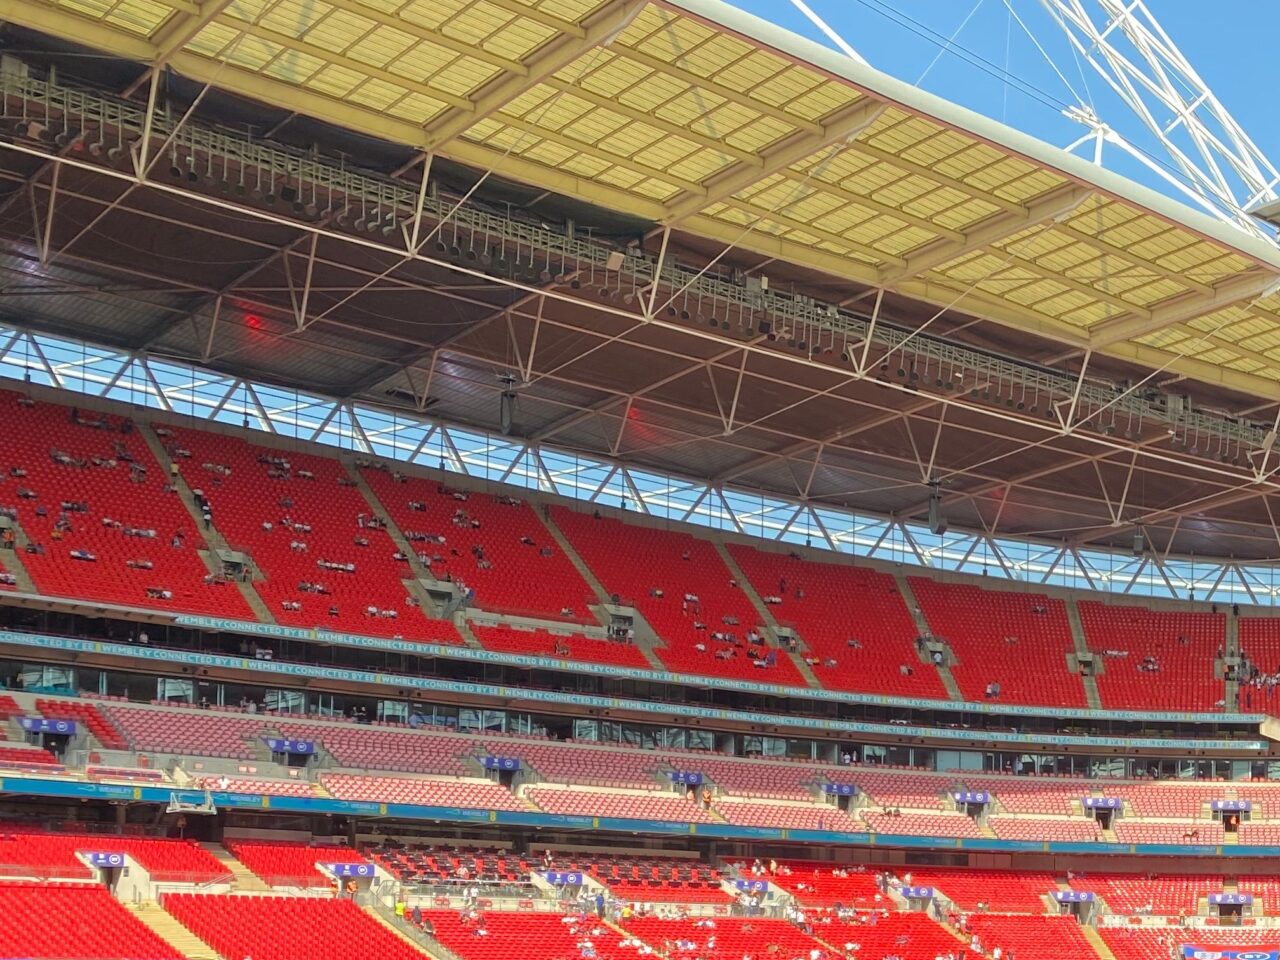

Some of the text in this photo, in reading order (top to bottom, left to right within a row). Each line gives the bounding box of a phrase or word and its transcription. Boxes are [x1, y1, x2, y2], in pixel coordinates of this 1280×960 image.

[175, 615, 223, 627] WEMBLEY
[223, 621, 282, 634] CONNECTED
[283, 628, 299, 636] BY
[65, 639, 80, 648] BY
[316, 632, 361, 644] WEMBLEY
[361, 637, 415, 650] CONNECTED
[416, 644, 428, 652] BY
[102, 644, 152, 656] WEMBLEY
[153, 650, 213, 663] CONNECTED
[214, 657, 229, 665] BY
[446, 647, 488, 659] WEMBLEY
[487, 652, 536, 665] CONNECTED
[248, 660, 294, 672] WEMBLEY
[294, 665, 349, 678] CONNECTED
[350, 671, 364, 680] BY
[566, 662, 605, 673] WEMBLEY
[604, 666, 651, 678] CONNECTED
[382, 675, 425, 686] WEMBLEY
[424, 679, 475, 692] CONNECTED
[678, 675, 715, 686] WEMBLEY
[714, 679, 759, 690] CONNECTED
[504, 688, 543, 699] WEMBLEY
[542, 692, 591, 704] CONNECTED
[783, 686, 818, 697] WEMBLEY
[618, 700, 656, 710] WEMBLEY
[655, 704, 701, 715] CONNECTED
[726, 711, 760, 721] WEMBLEY
[760, 715, 805, 725] CONNECTED
[98, 785, 132, 794] WEMBLEY
